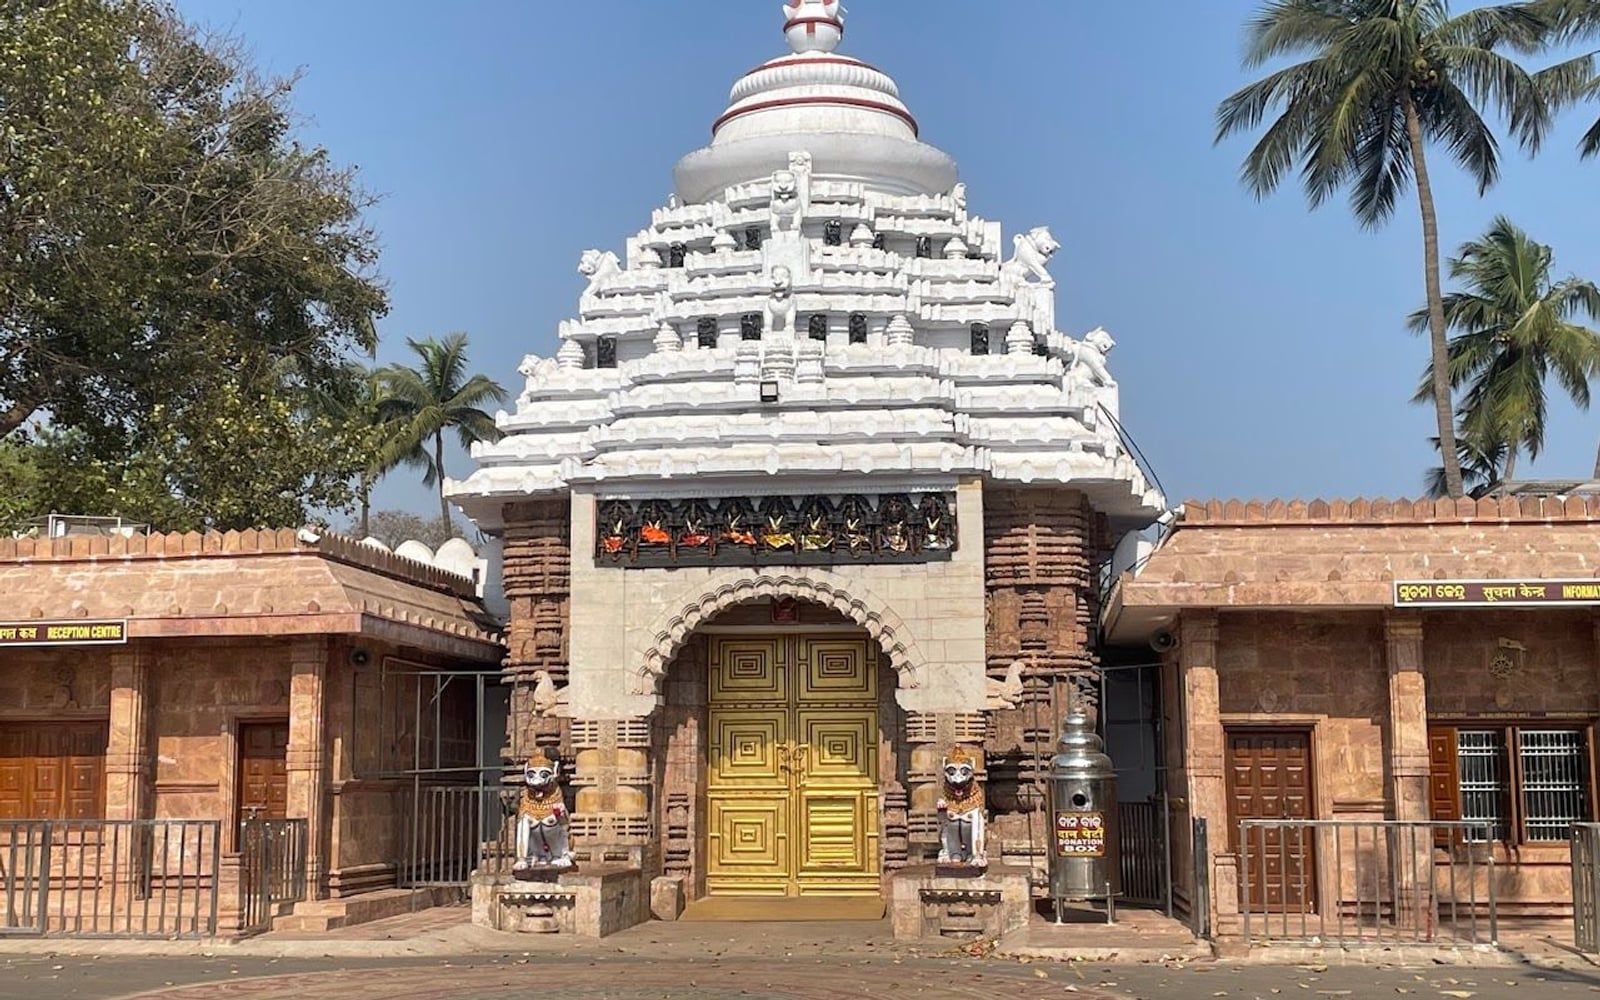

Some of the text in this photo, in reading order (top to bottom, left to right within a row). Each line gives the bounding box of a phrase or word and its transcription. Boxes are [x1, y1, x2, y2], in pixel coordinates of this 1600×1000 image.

[1482, 583, 1546, 601] सूचना केन्द्र
[47, 625, 121, 640] RECEPTION CENTRE
